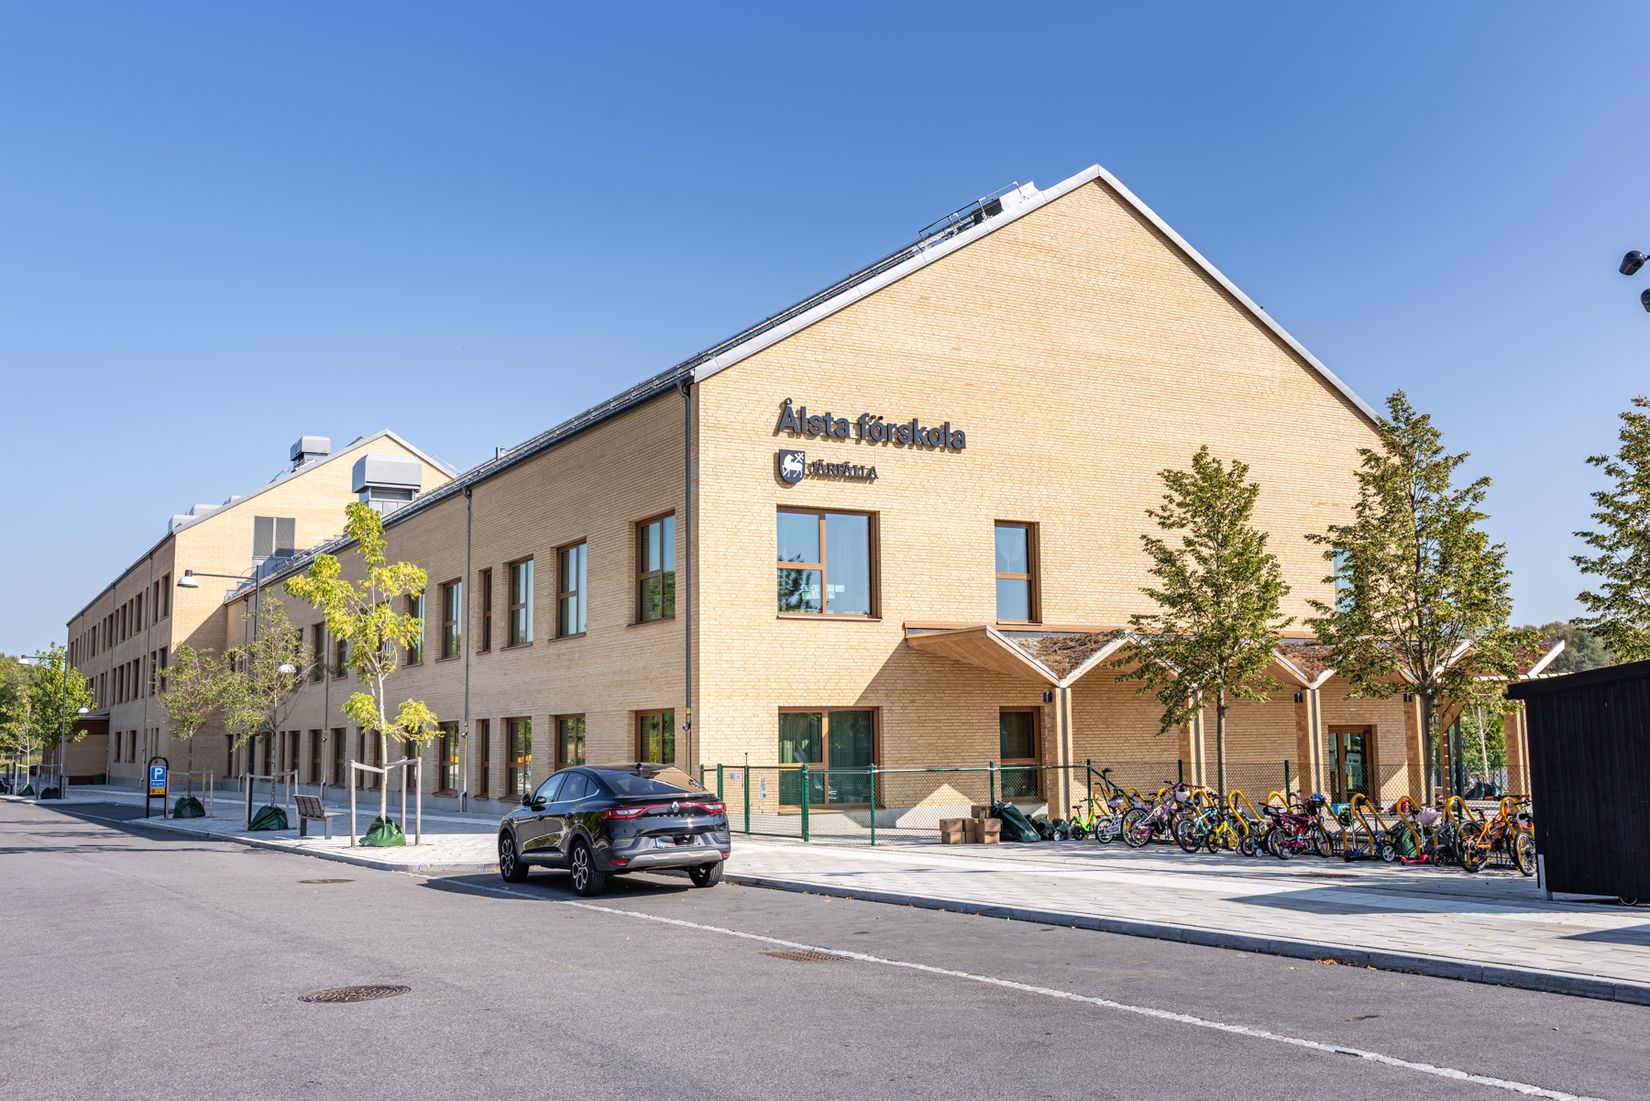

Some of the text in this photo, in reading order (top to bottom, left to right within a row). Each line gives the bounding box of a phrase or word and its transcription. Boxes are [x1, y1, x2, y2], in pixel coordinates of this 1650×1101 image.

[778, 397, 966, 450] Ålsta förskola
[811, 459, 879, 479] JÄRFÄLLA
[154, 767, 163, 779] P
